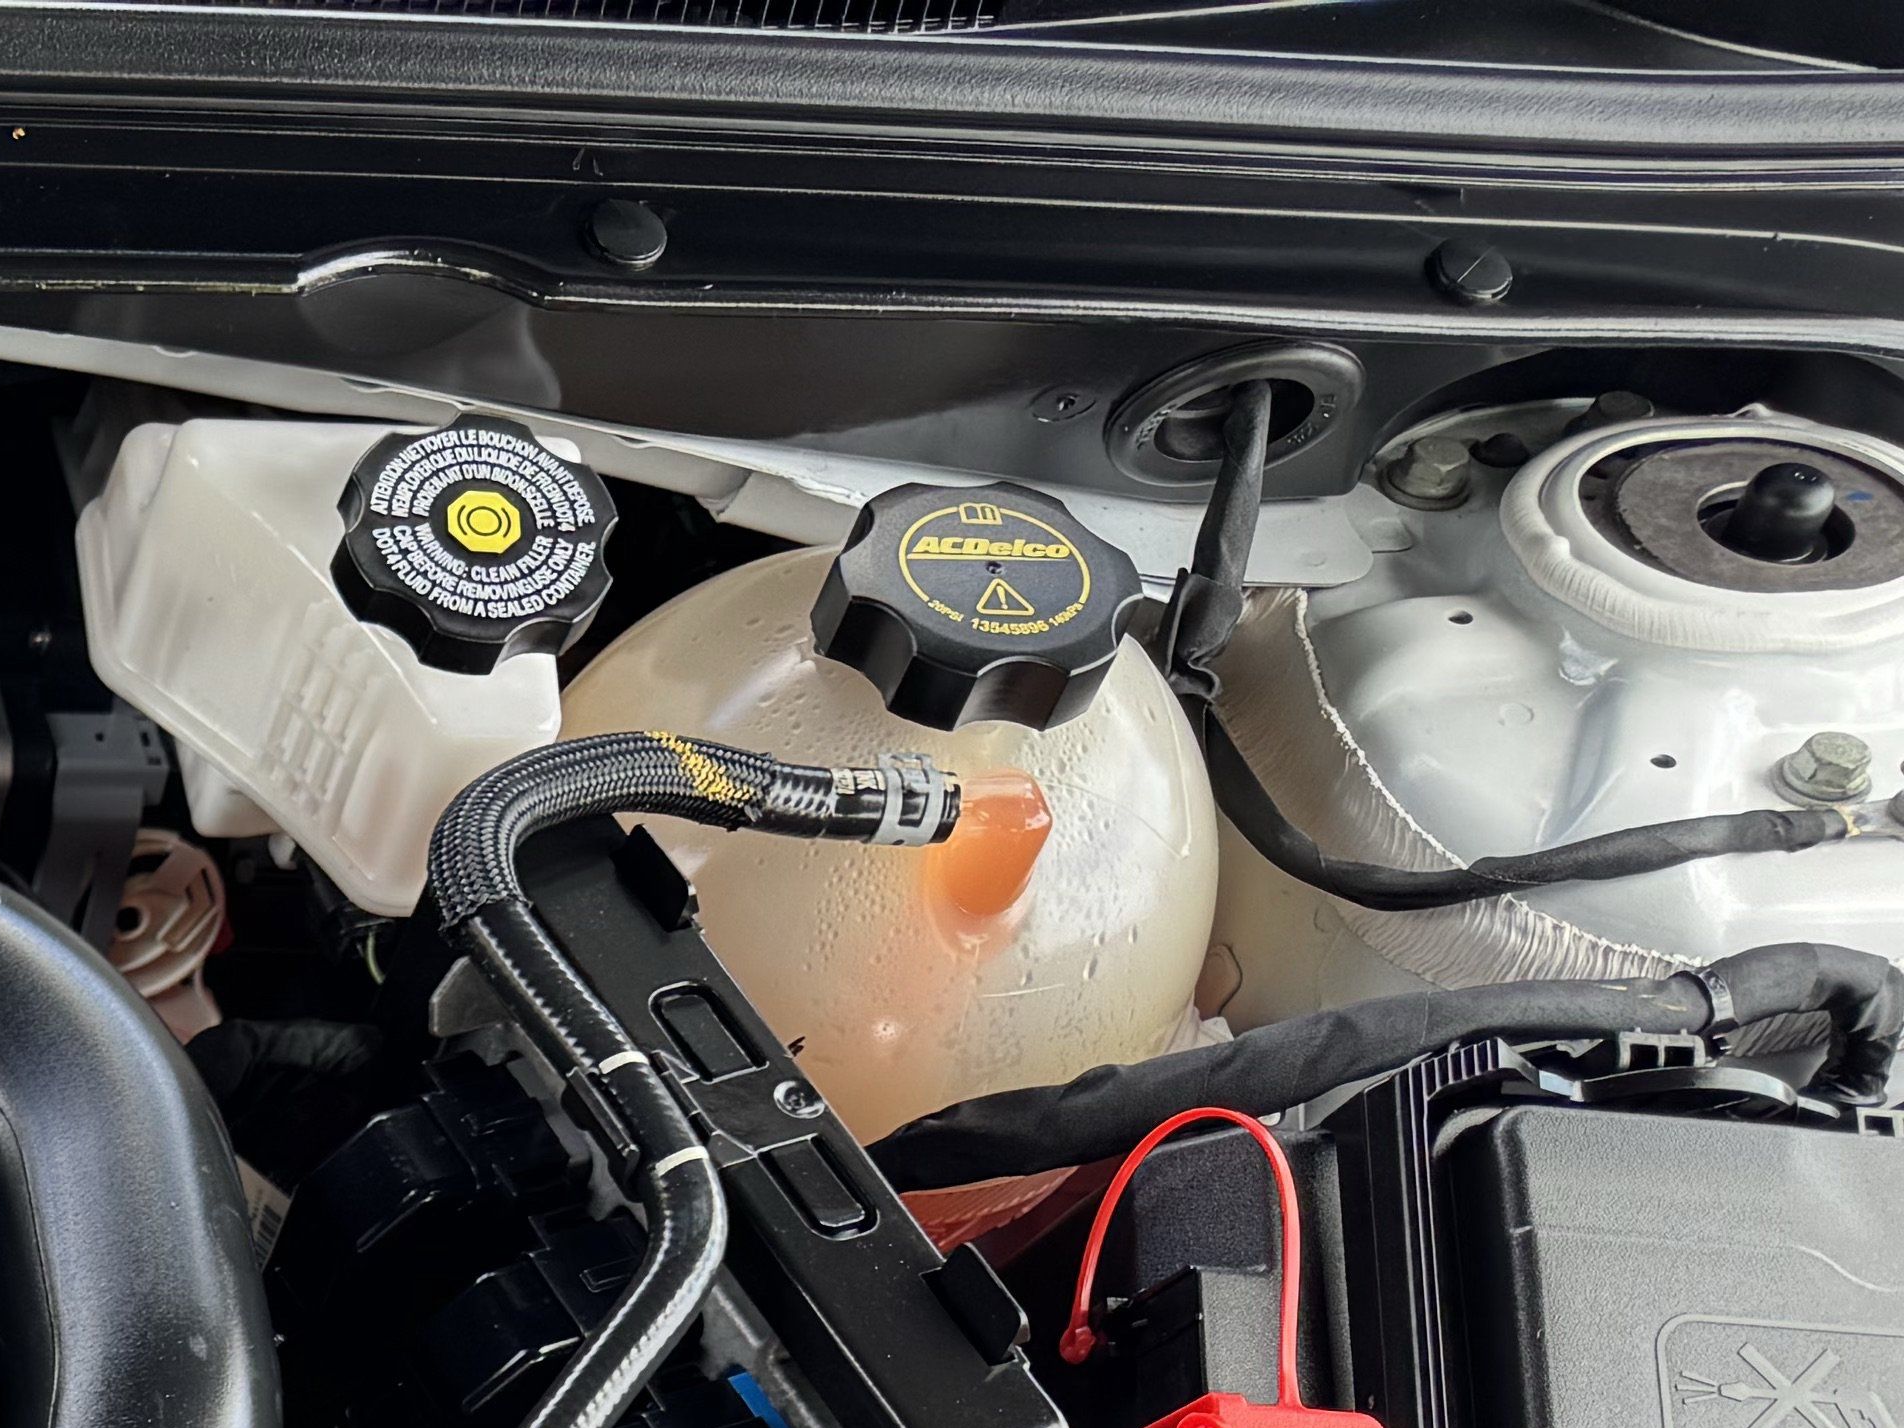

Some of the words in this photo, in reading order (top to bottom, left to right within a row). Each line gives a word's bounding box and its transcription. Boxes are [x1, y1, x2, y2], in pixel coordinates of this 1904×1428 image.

[429, 448, 457, 469] QUE
[455, 447, 473, 462] DU
[518, 460, 539, 480] DE
[532, 471, 565, 503] FREIN
[459, 429, 477, 445] LE
[478, 429, 539, 460] BOUCHON
[533, 452, 574, 484] AVANT
[411, 465, 463, 516] PROVENANT
[393, 525, 418, 551] CAP
[406, 549, 459, 591] BEFORE
[547, 538, 574, 571] ONLY
[414, 522, 469, 578] WARNING:
[471, 563, 521, 583] CLEAN
[516, 535, 553, 574] FILLER
[912, 536, 1071, 558] ACDelco
[391, 559, 433, 595] FLUID
[428, 586, 474, 615] FROM
[473, 601, 486, 618] A
[487, 594, 545, 618] SEALED
